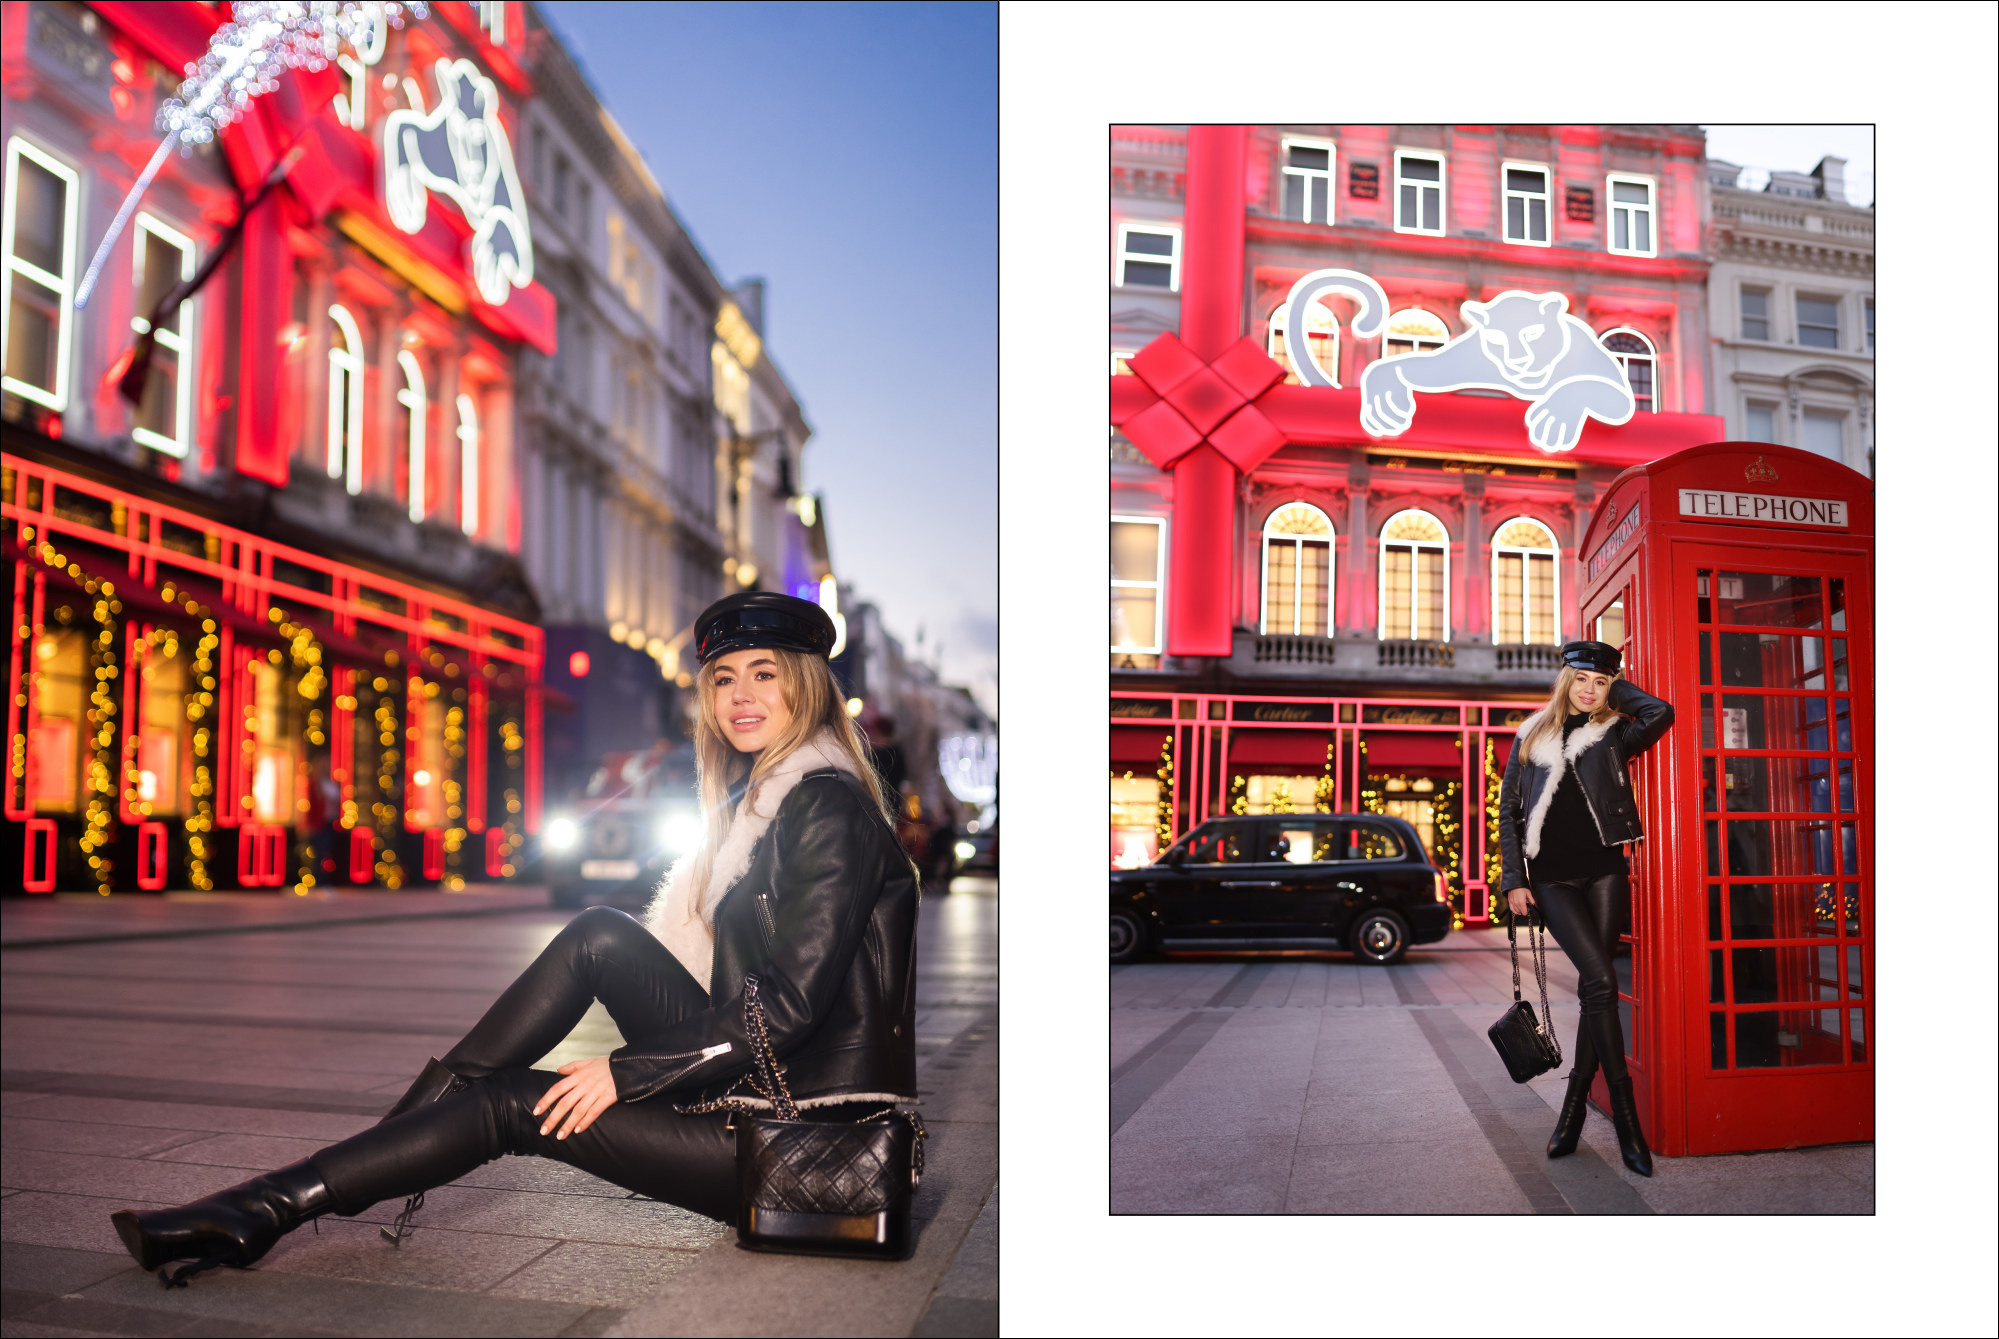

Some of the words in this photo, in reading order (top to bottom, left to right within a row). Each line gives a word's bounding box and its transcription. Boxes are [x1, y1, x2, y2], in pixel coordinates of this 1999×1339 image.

[1685, 492, 1842, 525] TELEPHONE
[1591, 504, 1639, 578] TELEPHONE
[1254, 704, 1313, 721] Cartier
[1382, 706, 1439, 725] Cartier
